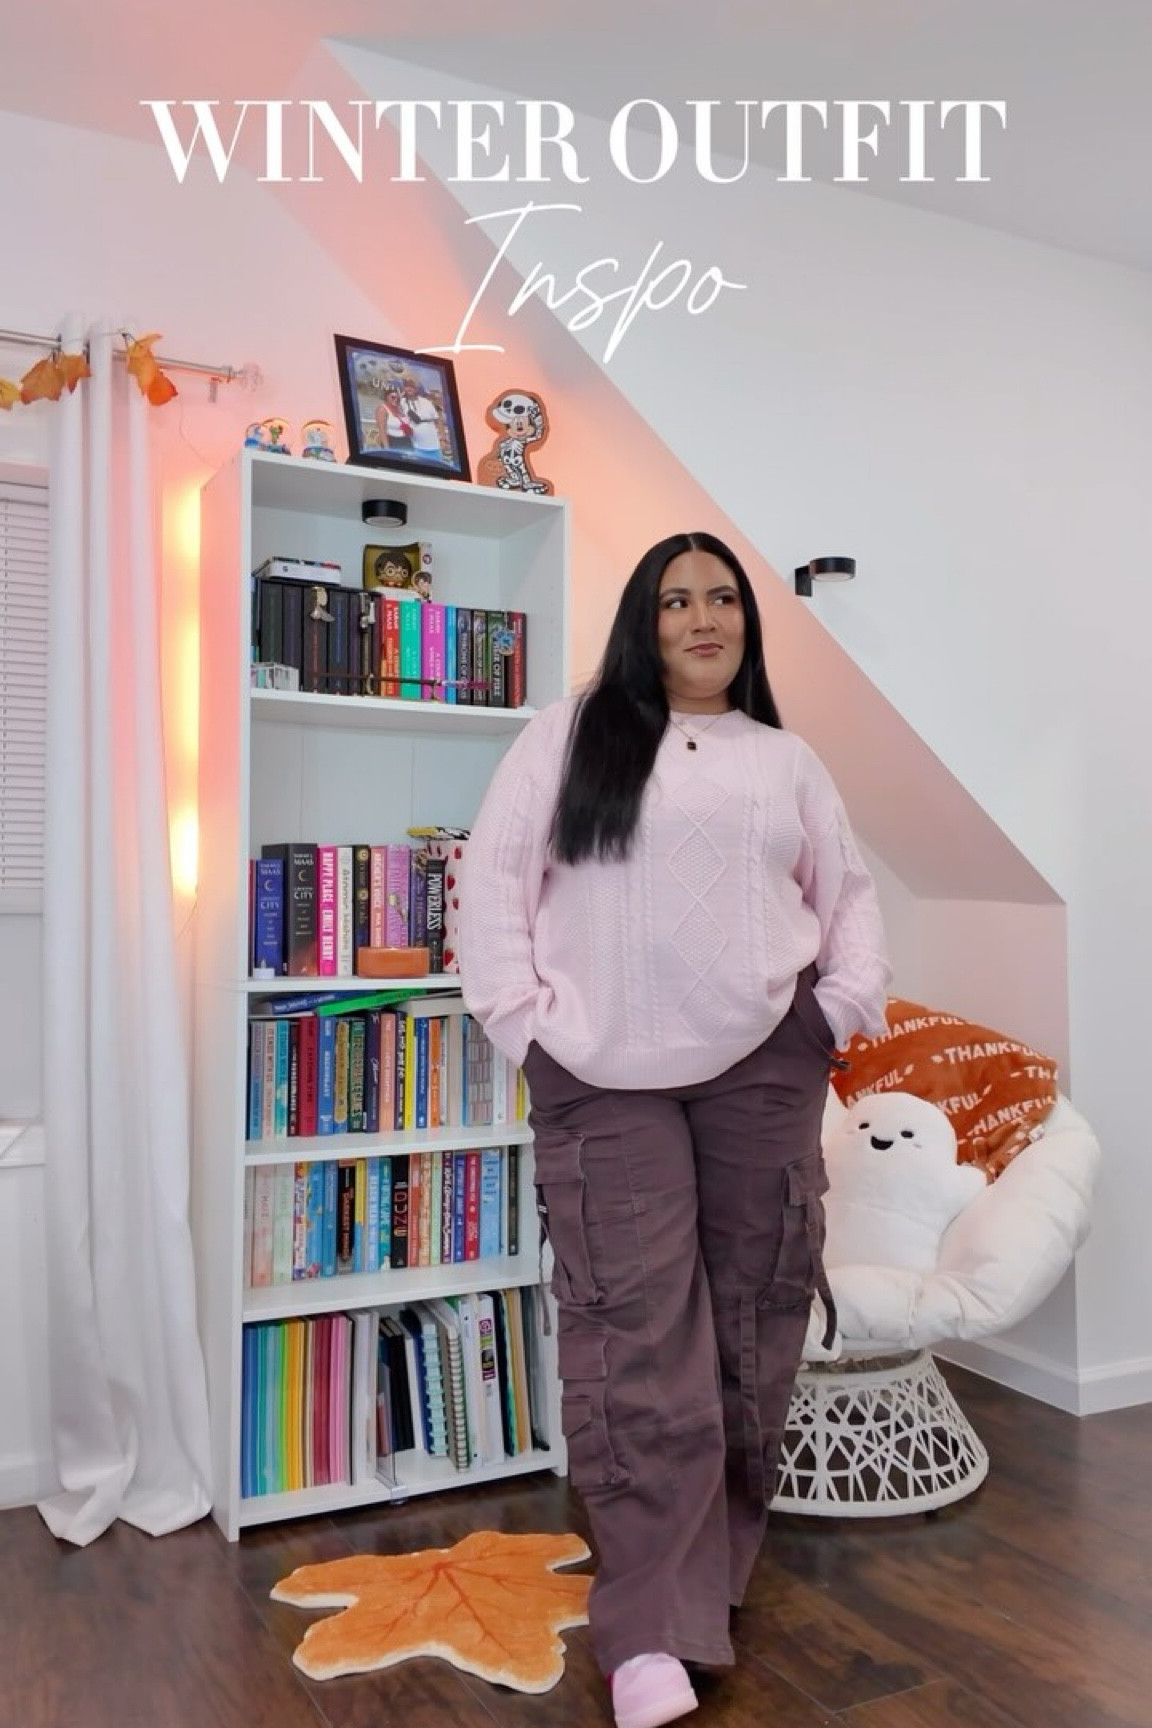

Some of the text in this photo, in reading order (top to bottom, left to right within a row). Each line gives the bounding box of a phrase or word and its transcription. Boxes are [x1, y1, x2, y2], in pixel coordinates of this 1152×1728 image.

[492, 663, 502, 676] OF
[492, 677, 502, 698] FIRE
[321, 852, 334, 877] HAPPY
[294, 890, 313, 900] CITY
[321, 879, 334, 903] PLACE
[373, 887, 385, 909] VOICE
[426, 872, 444, 931] POWERLESS
[341, 1192, 351, 1231] DARKEST
